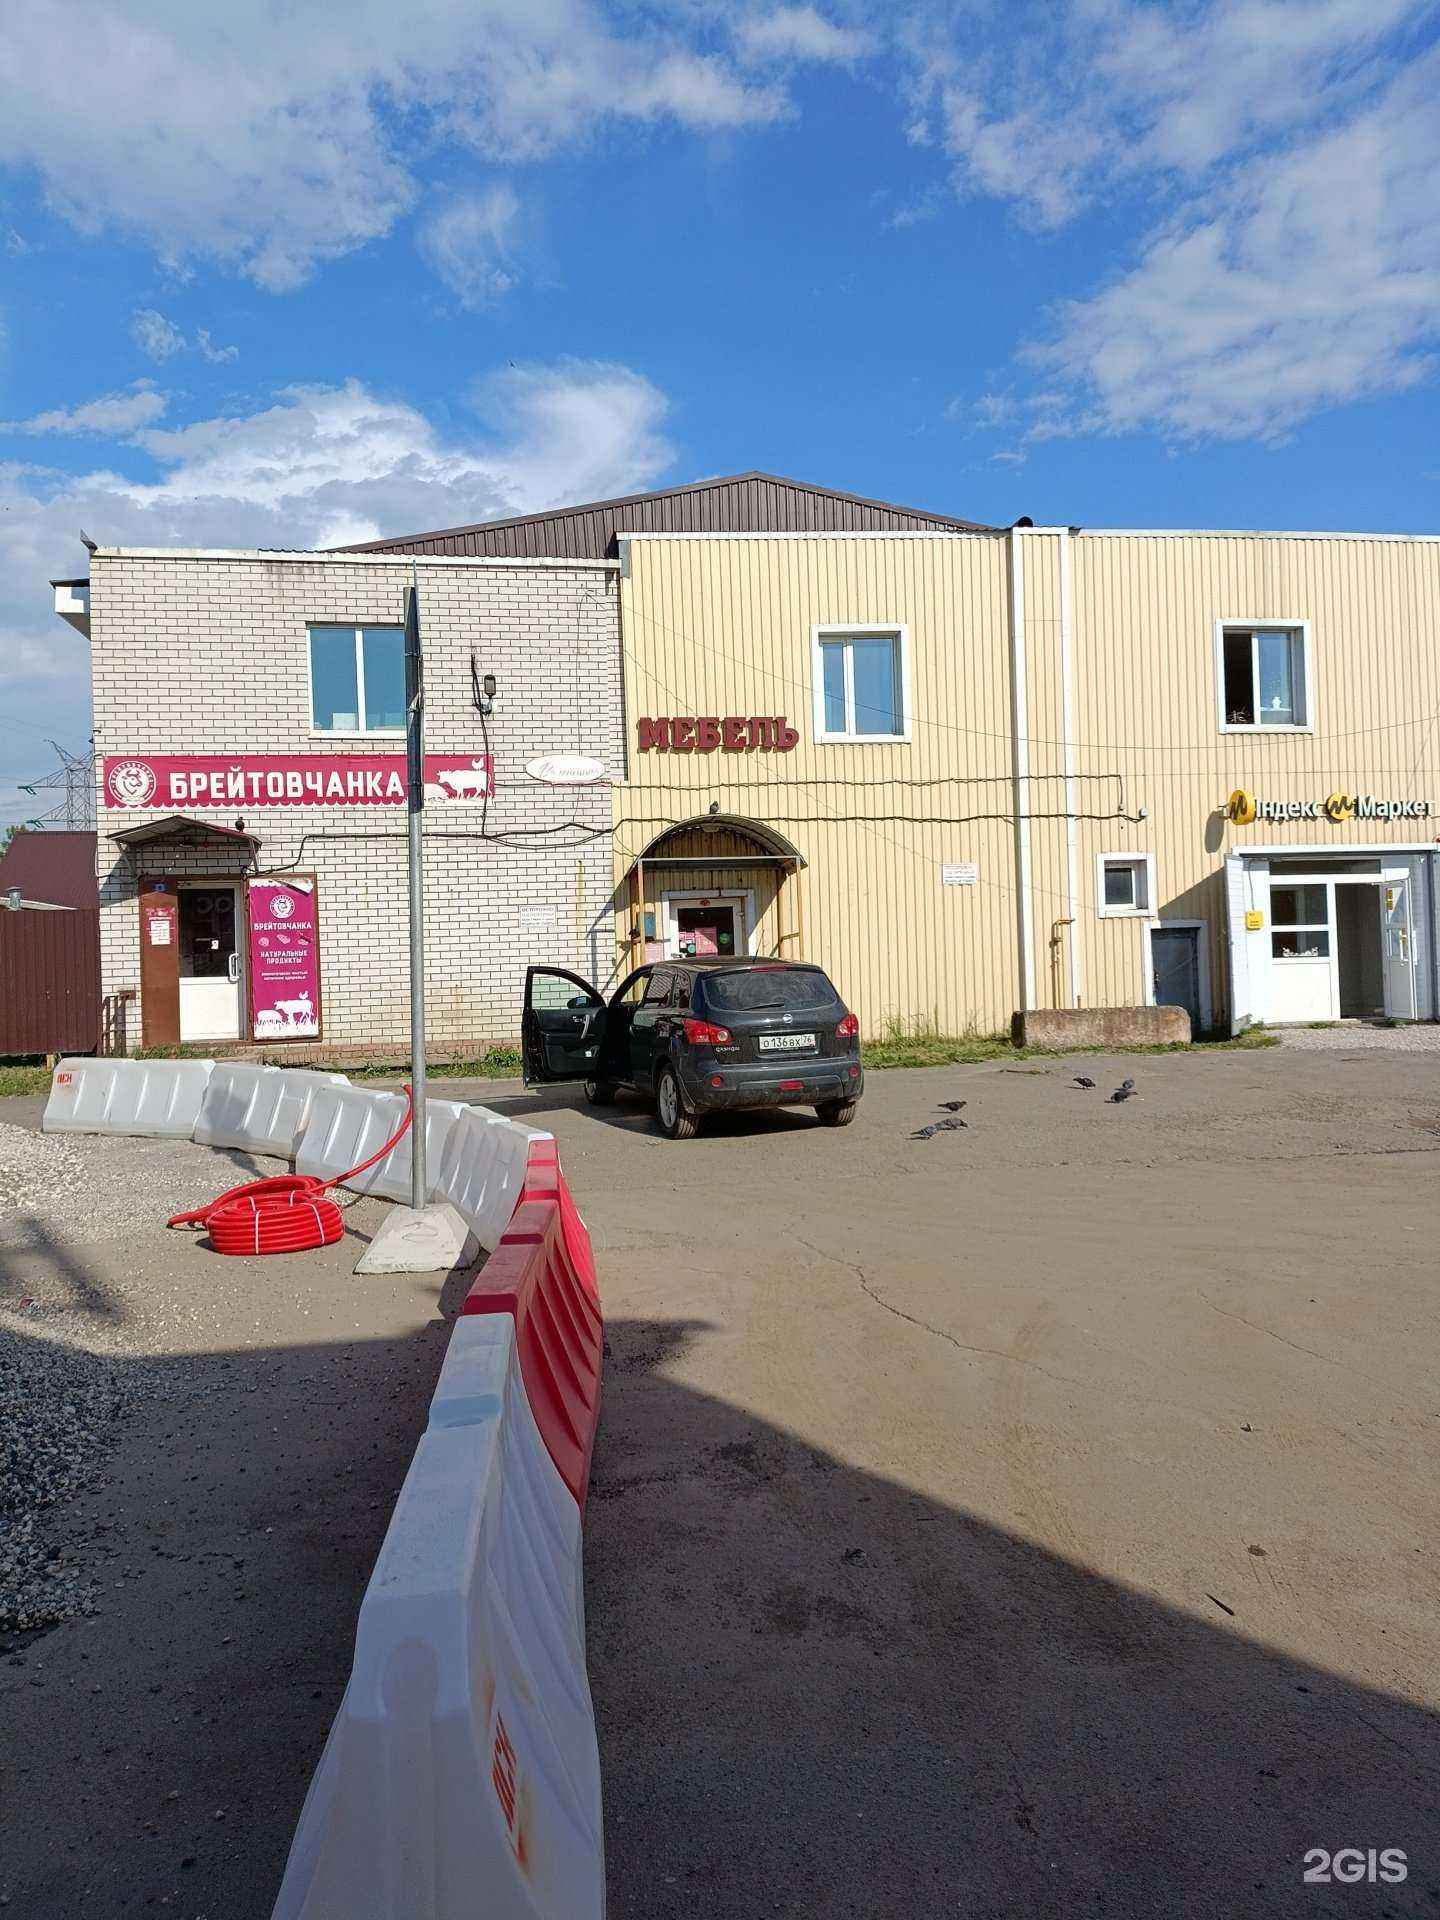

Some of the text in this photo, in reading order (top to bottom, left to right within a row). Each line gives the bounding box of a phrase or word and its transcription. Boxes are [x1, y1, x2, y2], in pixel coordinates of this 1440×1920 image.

[637, 717, 799, 749] МЕБЕЛЬ
[169, 766, 405, 799] БРЕЙТОВЧАНКА
[1256, 794, 1437, 820] ндекс Маркет
[254, 922, 312, 930] БРЕЙТОВЧАНКА
[260, 950, 308, 958] НАТУРАЛЬНЫЕ
